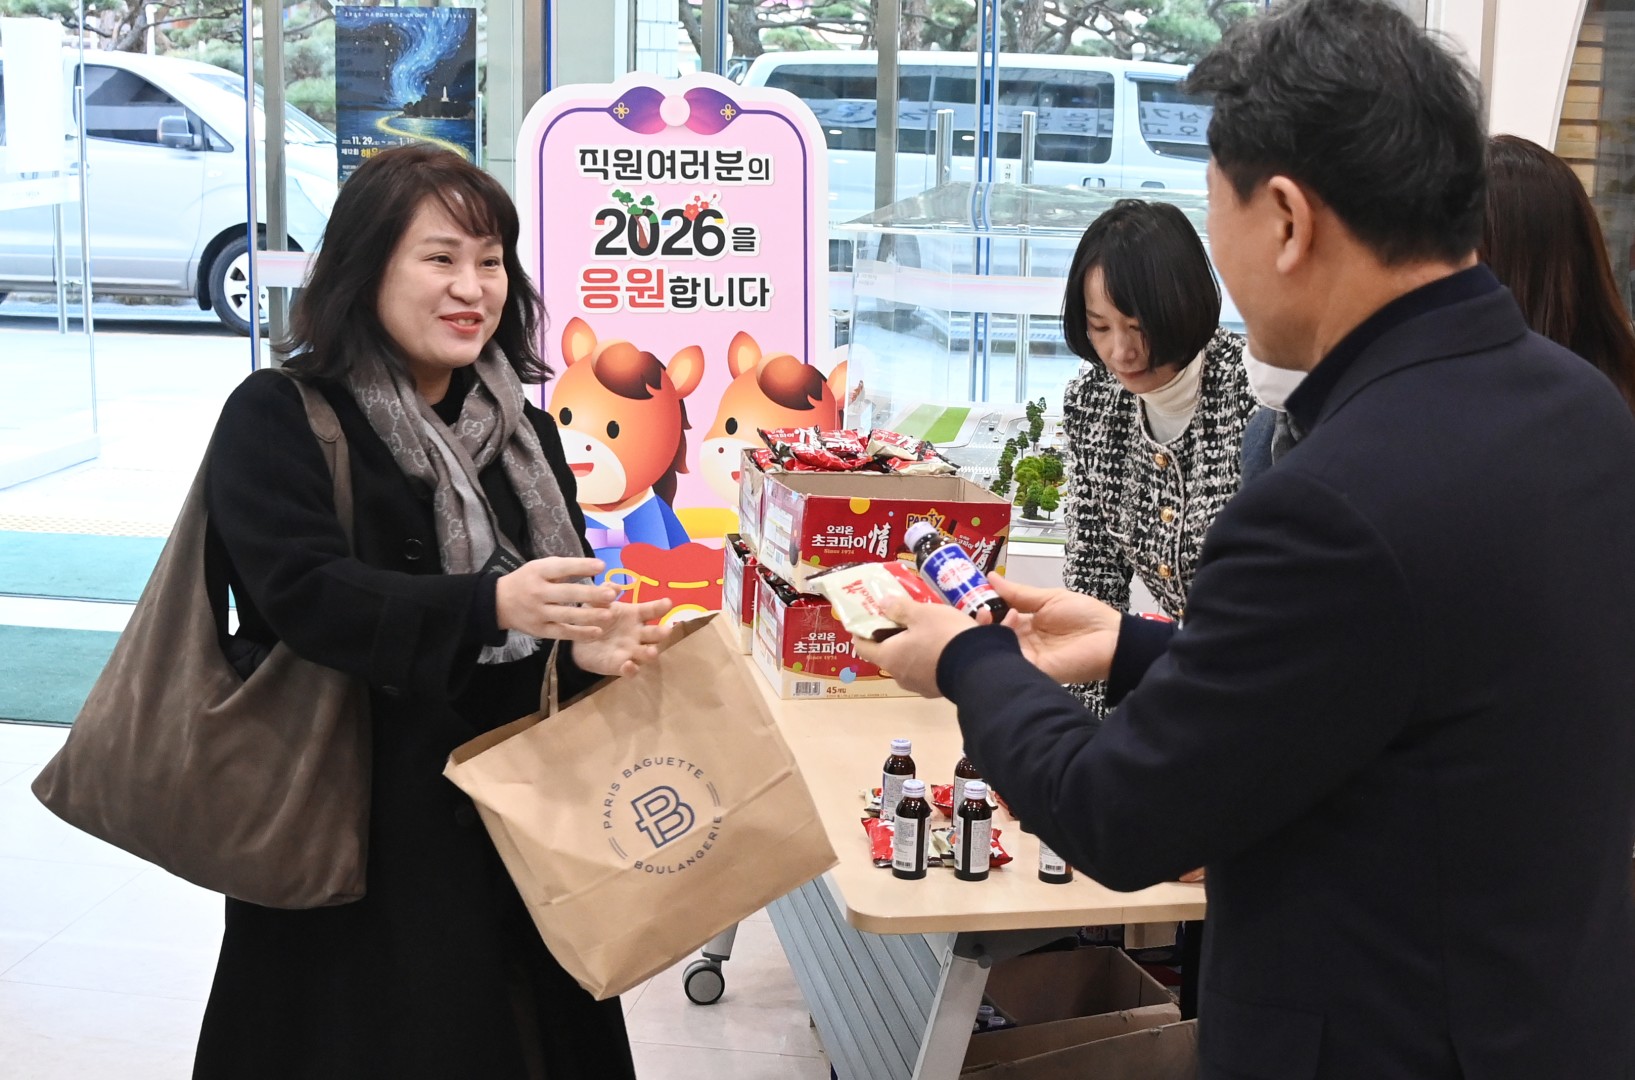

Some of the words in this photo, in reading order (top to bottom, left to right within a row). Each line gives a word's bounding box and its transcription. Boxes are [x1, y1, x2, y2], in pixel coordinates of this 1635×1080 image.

[580, 268, 770, 309] 응원합니다
[826, 525, 854, 535] 오리온
[811, 534, 868, 550] 초코파이
[808, 632, 836, 642] 오리온
[793, 640, 850, 655] 초코파이
[603, 782, 621, 829] PARIS
[622, 757, 704, 779] BAGUETTE
[634, 815, 722, 875] BOULANGERIE
